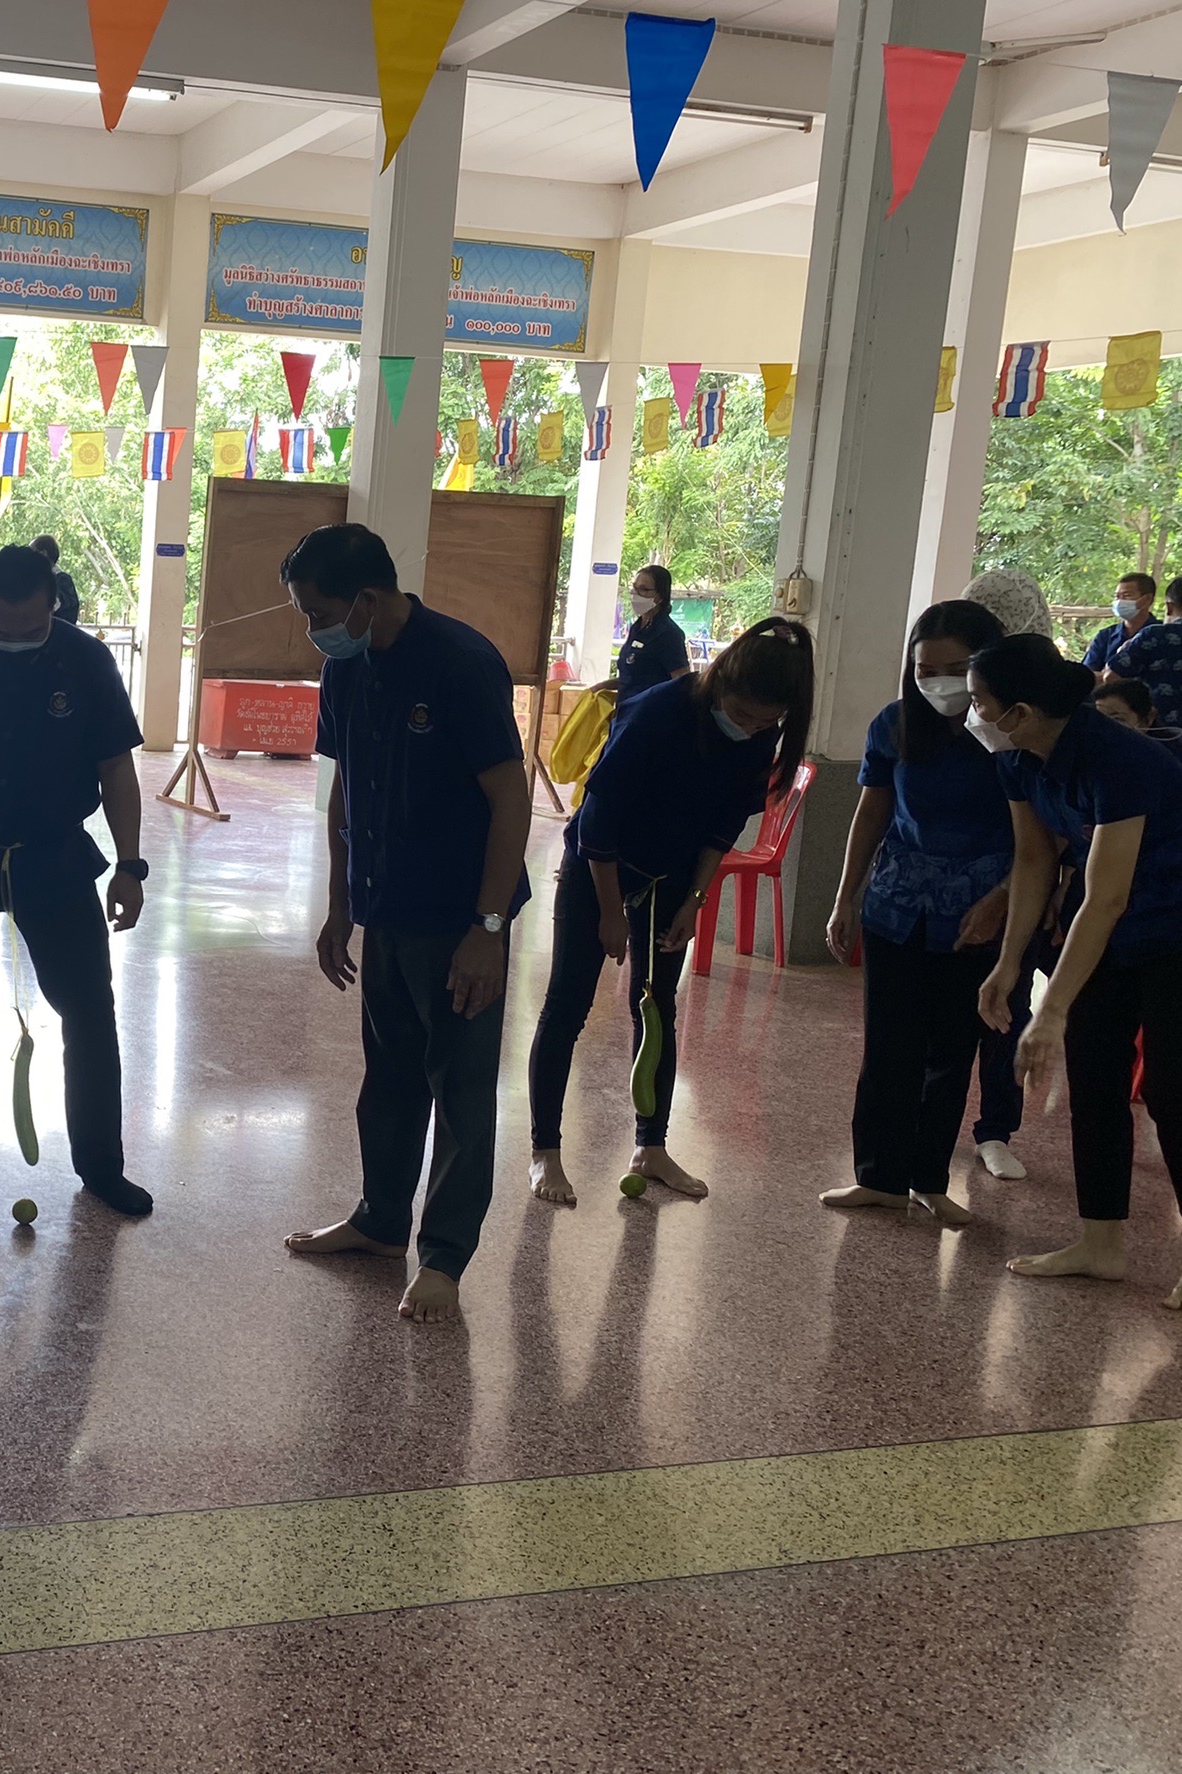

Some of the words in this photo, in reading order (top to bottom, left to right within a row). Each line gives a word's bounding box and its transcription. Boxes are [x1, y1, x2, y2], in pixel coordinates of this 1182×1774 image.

[88, 285, 117, 302] บาท
[465, 319, 521, 335] ๑๐๐,๐๐๐
[526, 321, 552, 336] บาท
